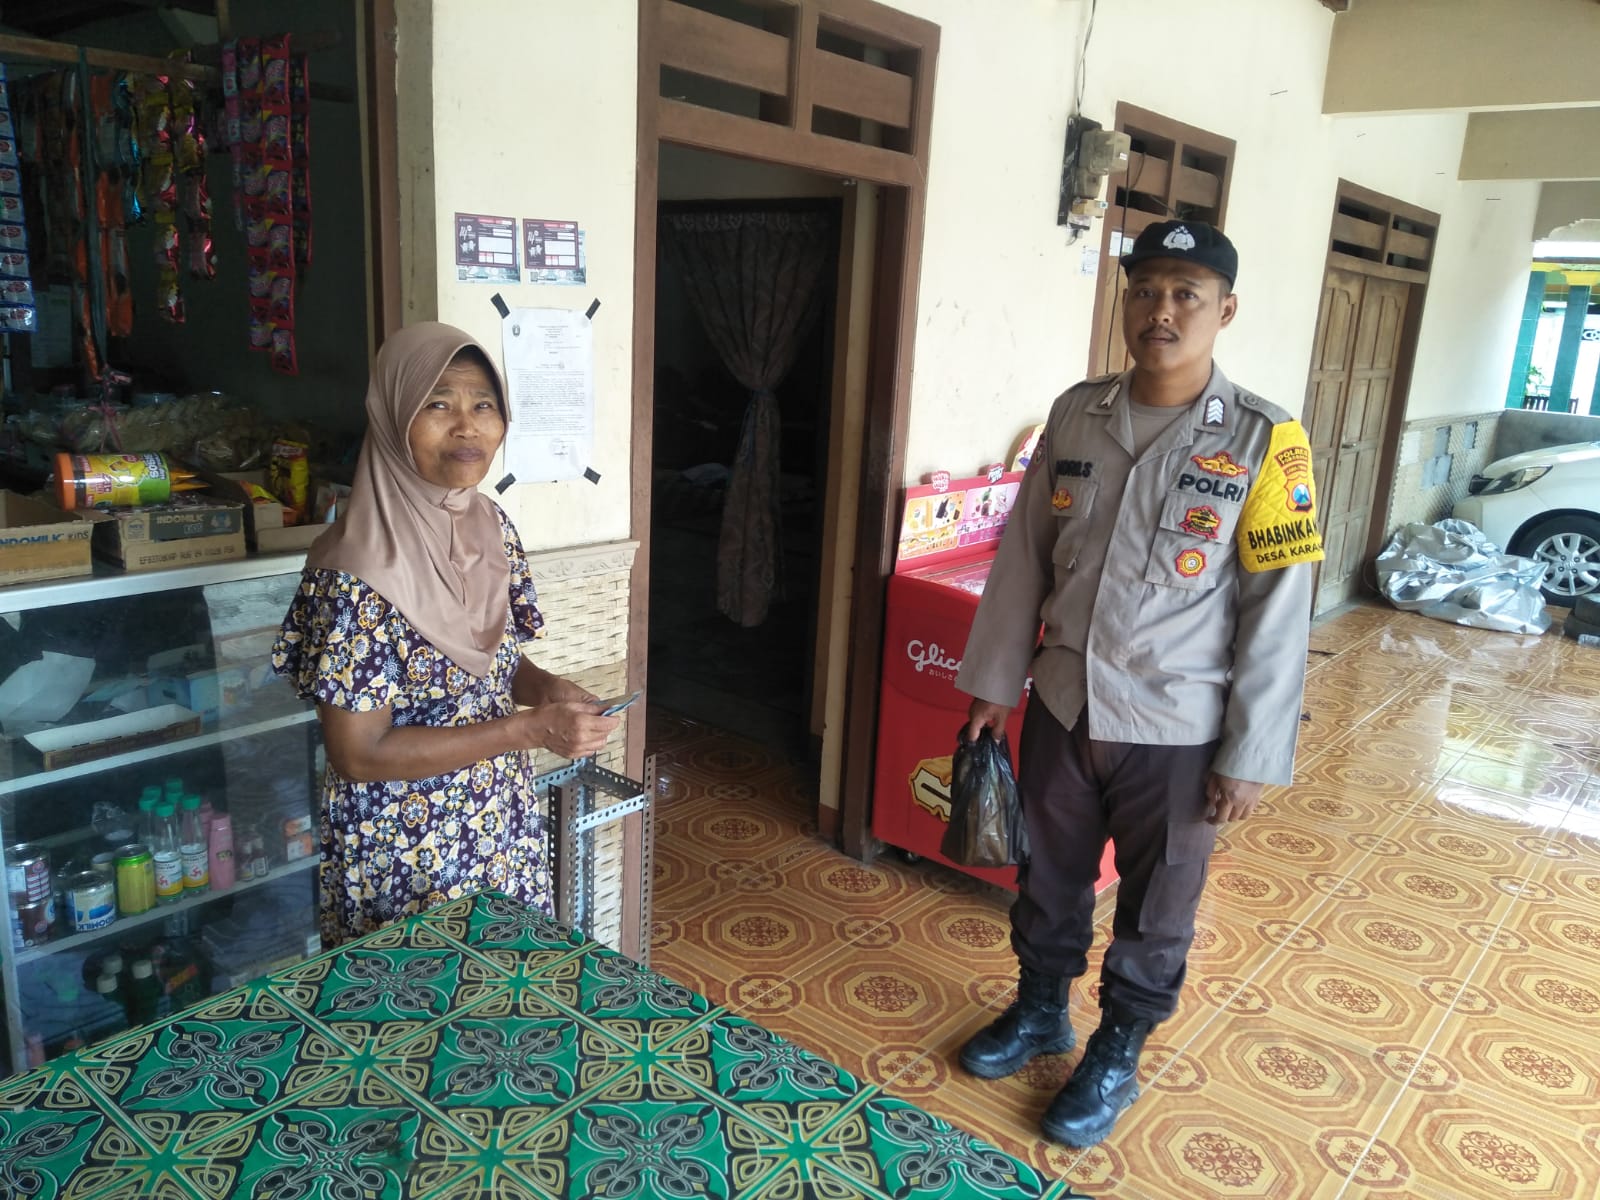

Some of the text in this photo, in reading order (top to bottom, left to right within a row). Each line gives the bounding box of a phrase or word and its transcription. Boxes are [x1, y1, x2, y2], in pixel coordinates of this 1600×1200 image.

[1178, 473, 1245, 502] POLRI
[1256, 549, 1286, 563] DESA
[907, 640, 962, 672] Glic
